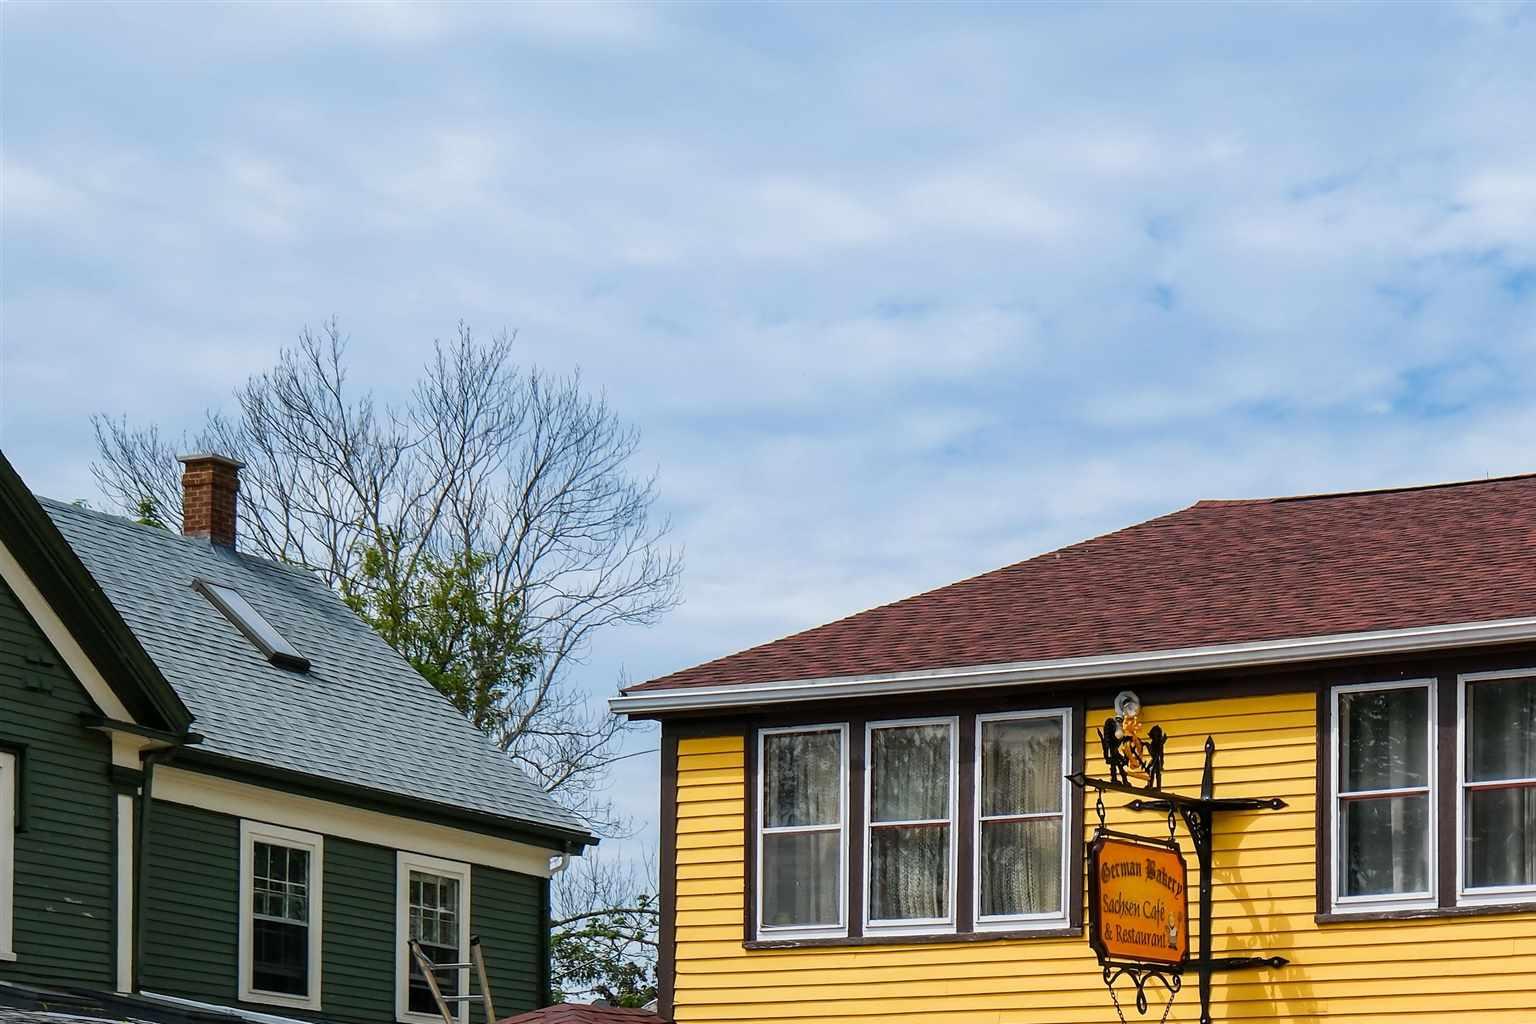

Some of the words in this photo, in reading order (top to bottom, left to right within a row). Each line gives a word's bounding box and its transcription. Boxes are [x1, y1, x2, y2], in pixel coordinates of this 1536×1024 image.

[1102, 861, 1141, 883] German
[1146, 858, 1183, 899] Bakery
[1103, 891, 1140, 919] Sachsen
[1142, 900, 1165, 926] Café
[1104, 922, 1113, 940] &
[1115, 924, 1166, 948] Restaurant
